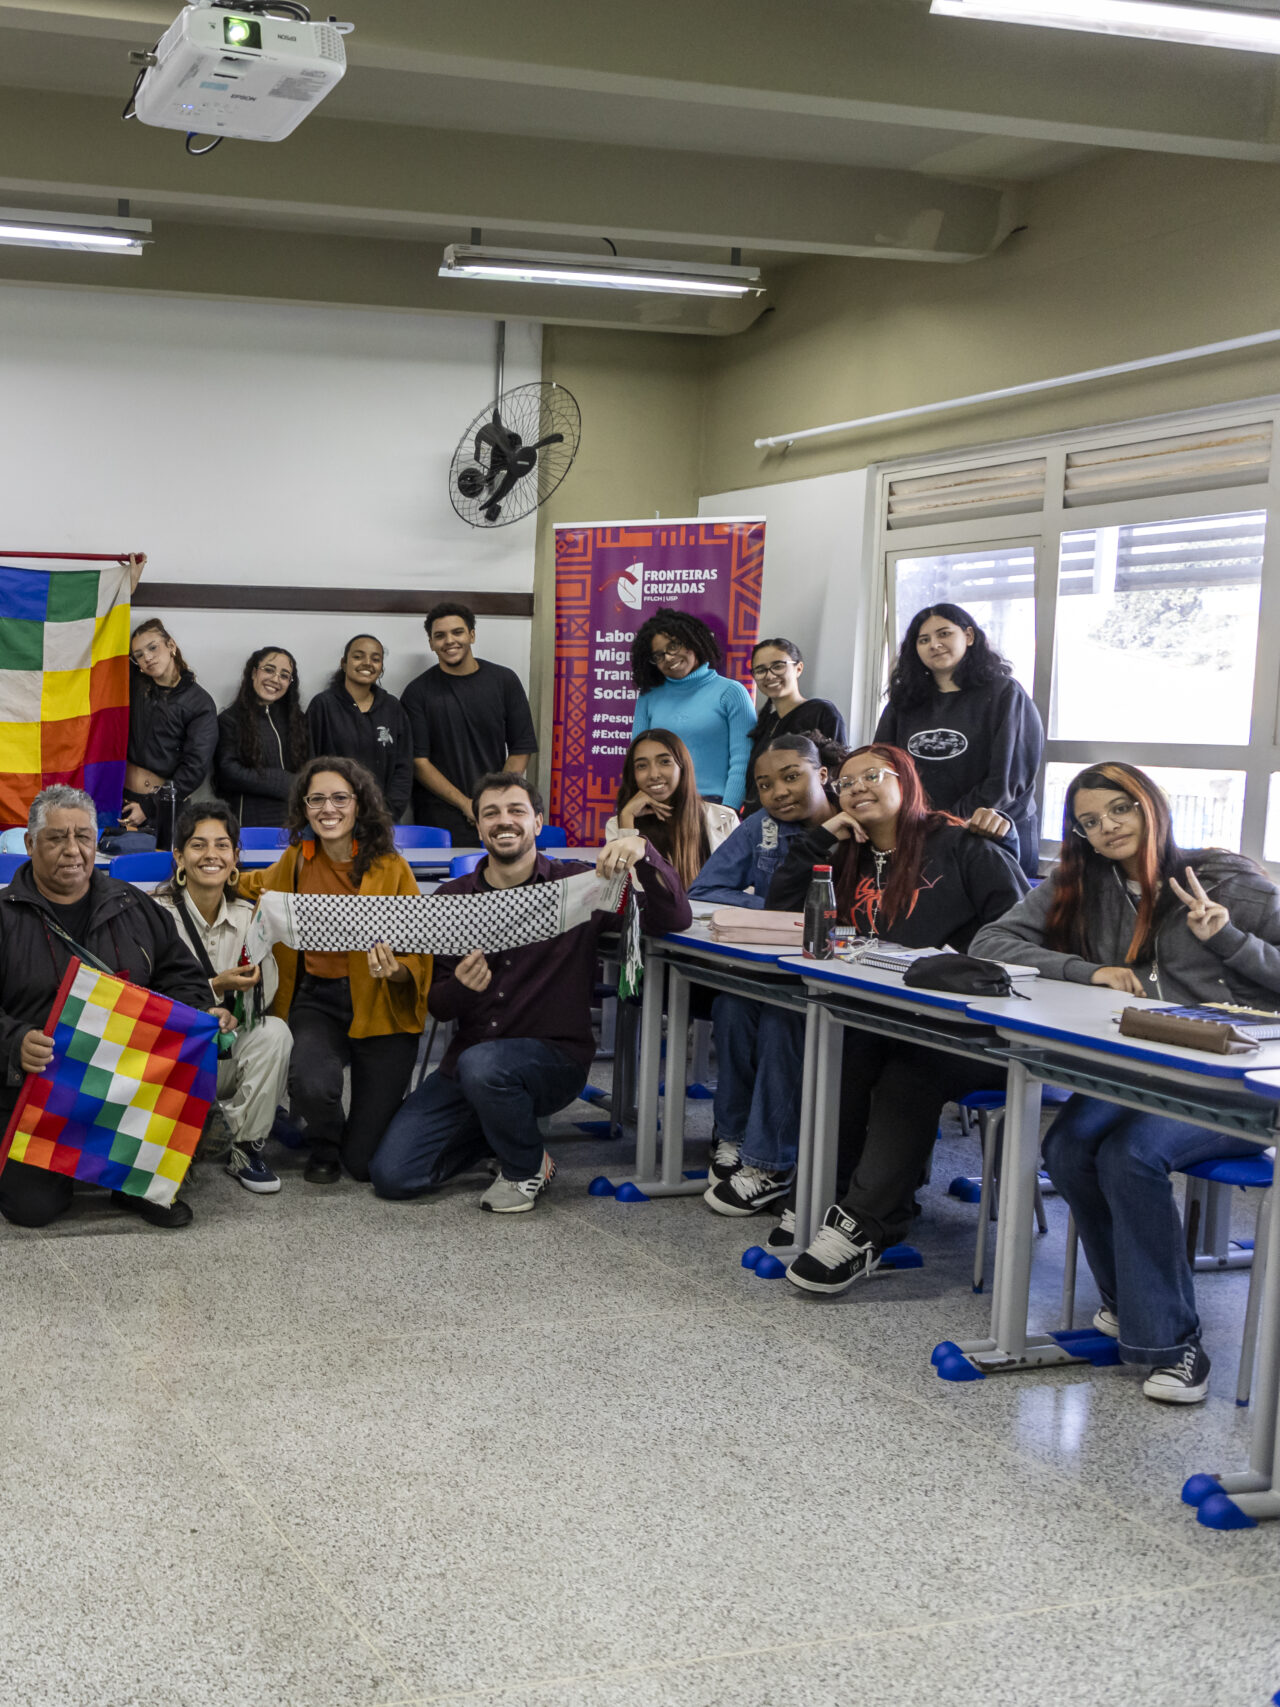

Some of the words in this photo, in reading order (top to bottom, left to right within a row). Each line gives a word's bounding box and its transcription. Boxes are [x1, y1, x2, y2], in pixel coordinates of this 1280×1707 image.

[644, 569, 718, 581] FRONTEIRAS
[643, 583, 706, 594] CRUZADAS
[595, 629, 638, 643] Labo
